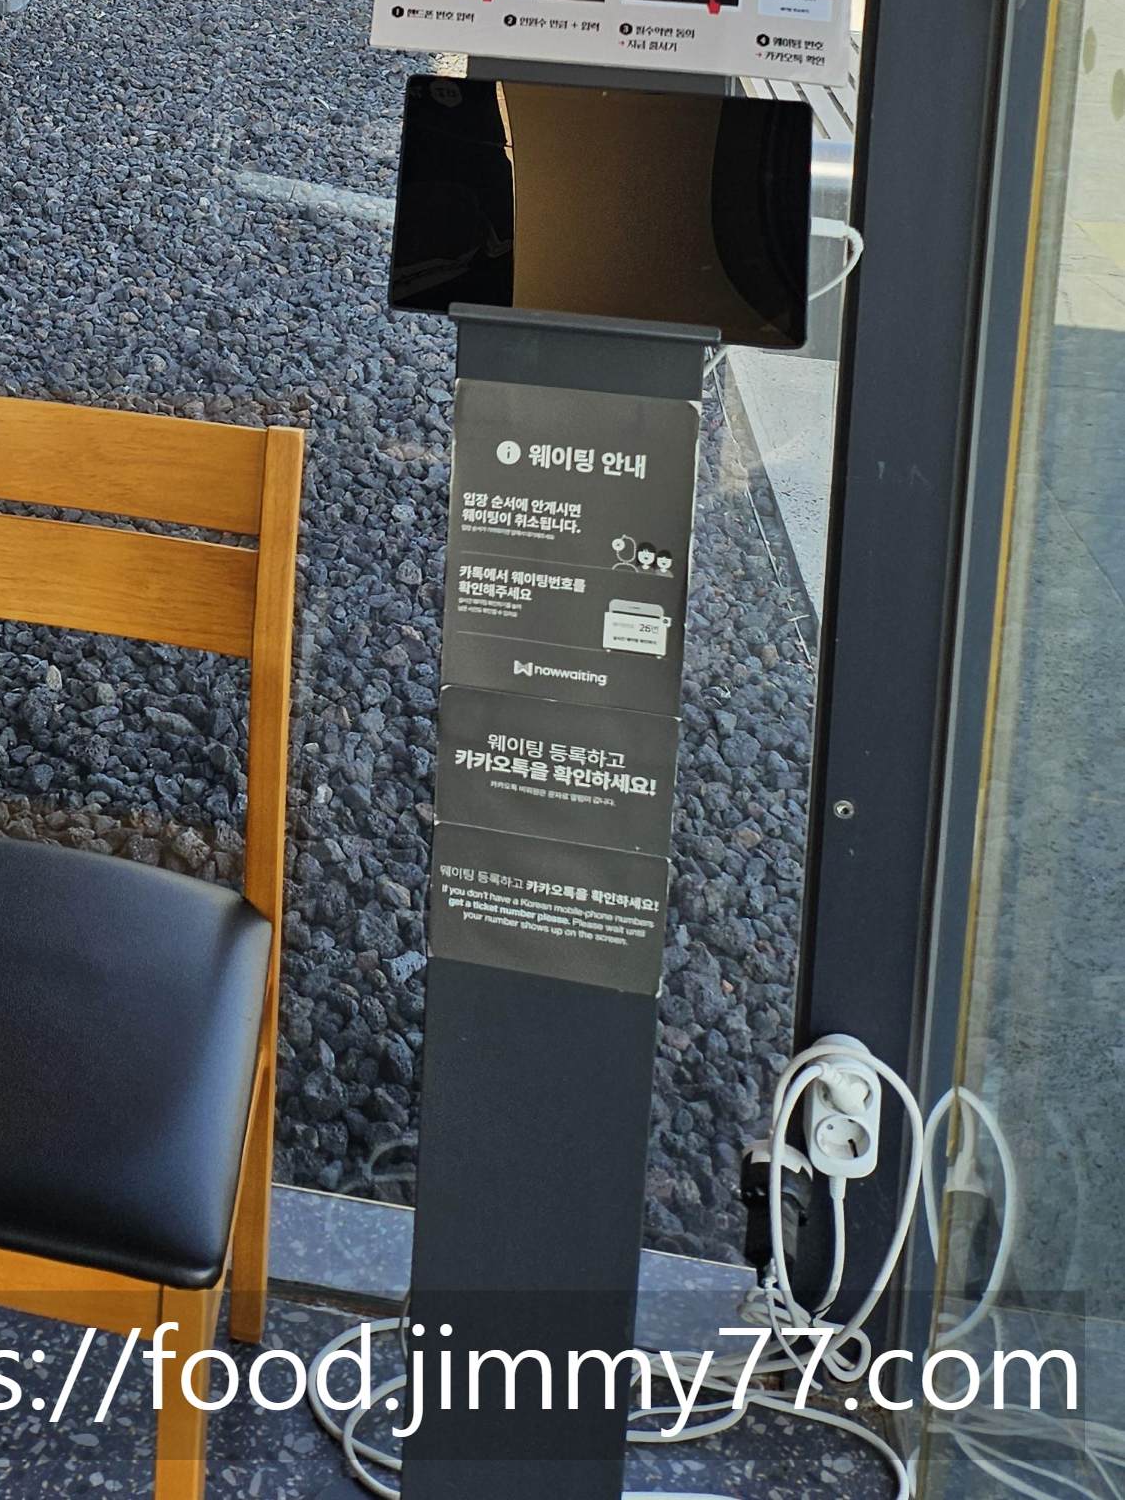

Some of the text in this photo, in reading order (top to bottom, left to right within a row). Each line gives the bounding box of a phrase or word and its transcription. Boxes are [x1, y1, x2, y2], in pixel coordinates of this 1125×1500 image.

[528, 444, 647, 480] 웨이팅 안내
[463, 492, 582, 518] 입장 순서에 안계시면
[461, 508, 512, 526] 웨이팅이
[514, 513, 582, 534] 취소됩니다.
[458, 580, 533, 601] 확인해주세요
[459, 565, 586, 594] 카톡에서 웨이팅번호를
[534, 661, 608, 687] nowwaiting
[487, 733, 626, 769] 웨이팅 등록하고
[454, 748, 657, 797] 카카오톡을 확인하세요!
[439, 864, 660, 913] 웨이팅 등록하고 카카오톡을 확인하세요!
[441, 884, 448, 893] If
[449, 887, 466, 896] you
[467, 889, 488, 900] don't
[489, 892, 512, 904] have
[520, 898, 553, 911] Korean
[614, 914, 655, 929] numbers
[448, 897, 464, 907] get
[465, 900, 472, 908] a
[473, 900, 499, 913] ticket
[499, 906, 536, 919] number
[462, 910, 484, 920] your
[484, 914, 519, 927] number
[520, 920, 550, 933] shows
[550, 927, 564, 936] up
[564, 929, 577, 937] on
[577, 930, 594, 940] the
